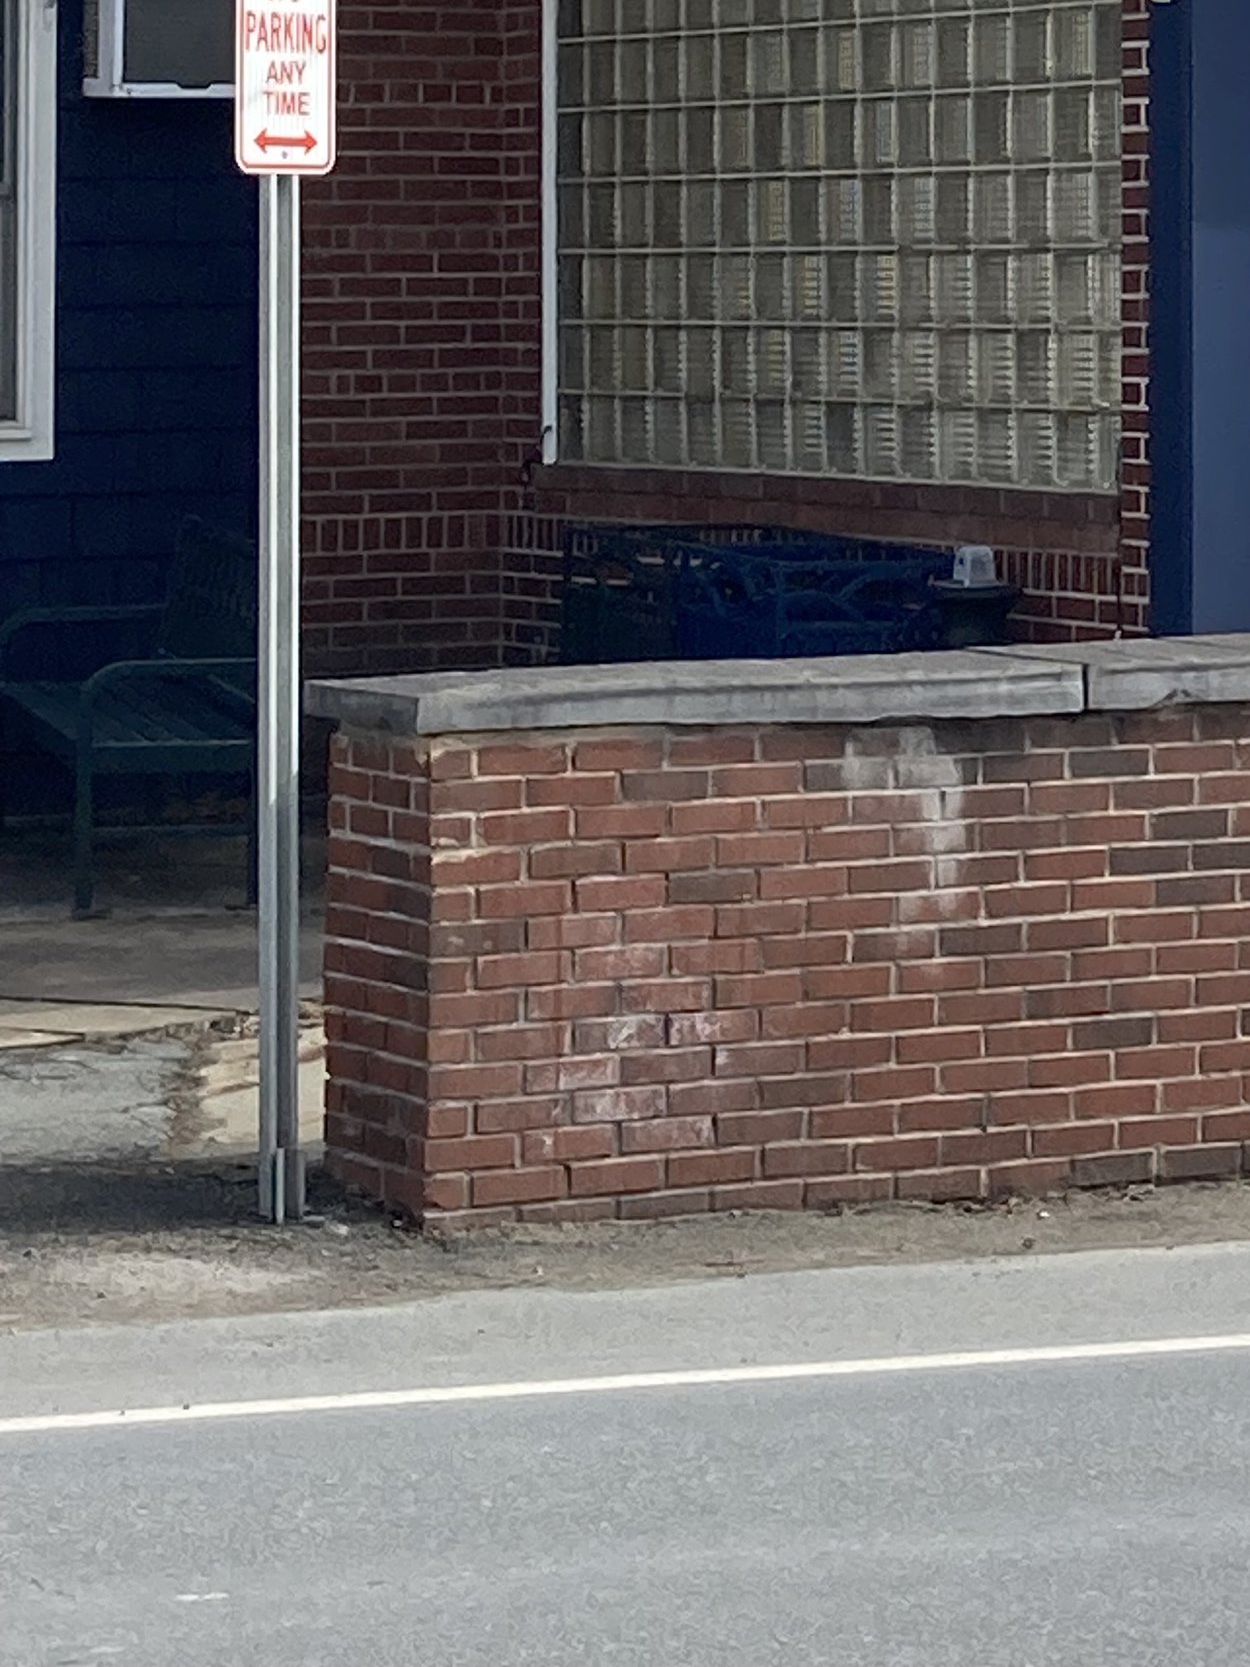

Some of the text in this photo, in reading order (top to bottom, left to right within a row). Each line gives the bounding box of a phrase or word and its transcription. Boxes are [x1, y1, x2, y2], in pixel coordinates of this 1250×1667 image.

[245, 10, 327, 54] PARKING
[265, 60, 307, 84] ANY
[262, 90, 310, 116] TIME
